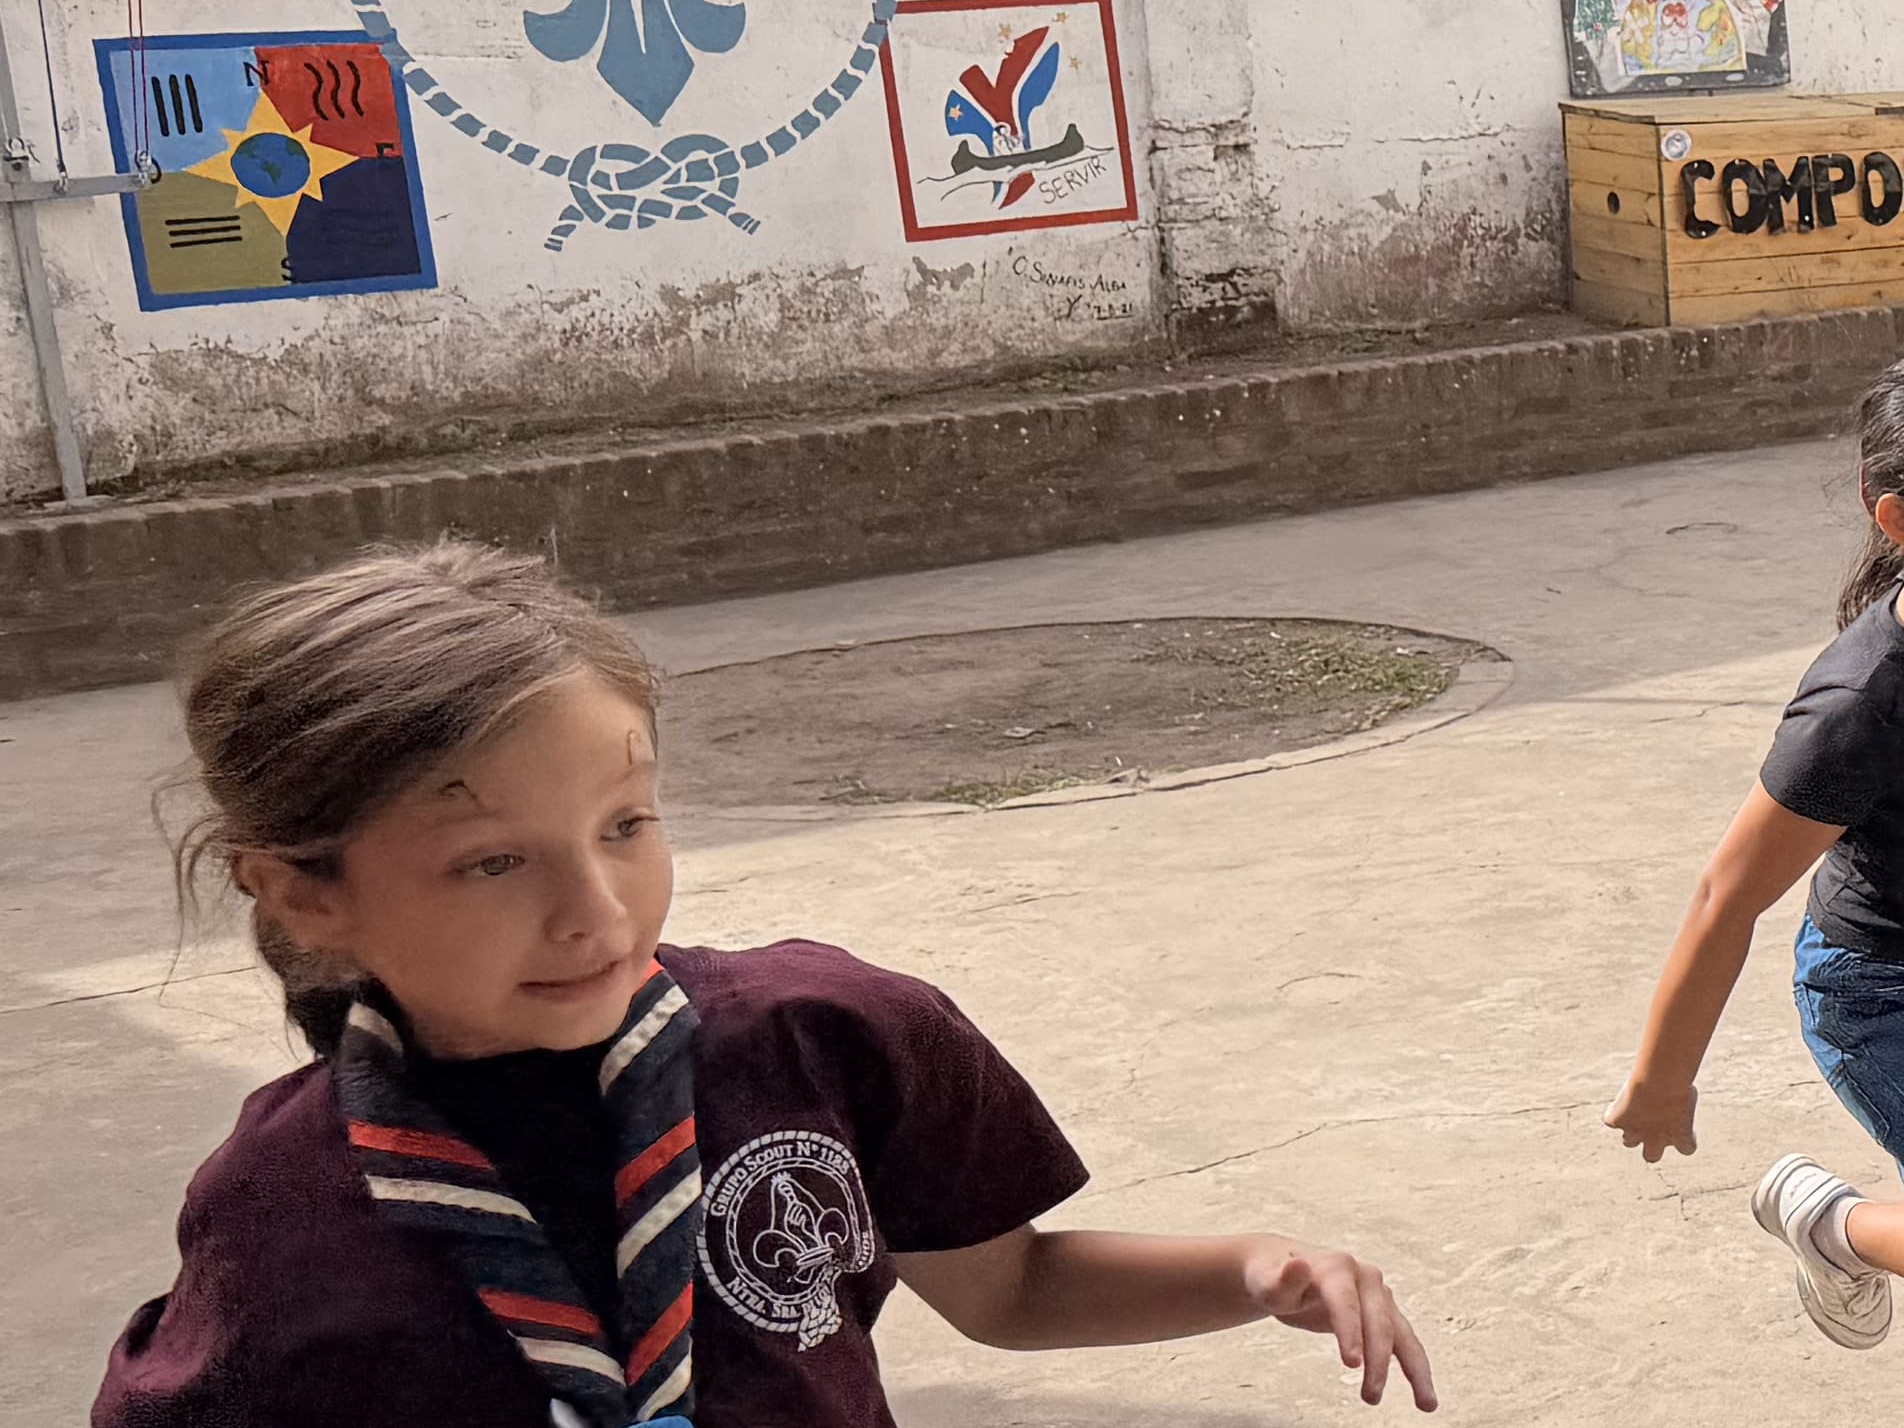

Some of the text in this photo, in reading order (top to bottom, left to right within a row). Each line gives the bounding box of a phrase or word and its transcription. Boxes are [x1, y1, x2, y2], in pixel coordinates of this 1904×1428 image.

[243, 60, 270, 87] N
[1038, 157, 1108, 205] SERVIR
[710, 1168, 748, 1217] GRUPO
[744, 1145, 794, 1172] SCOUT
